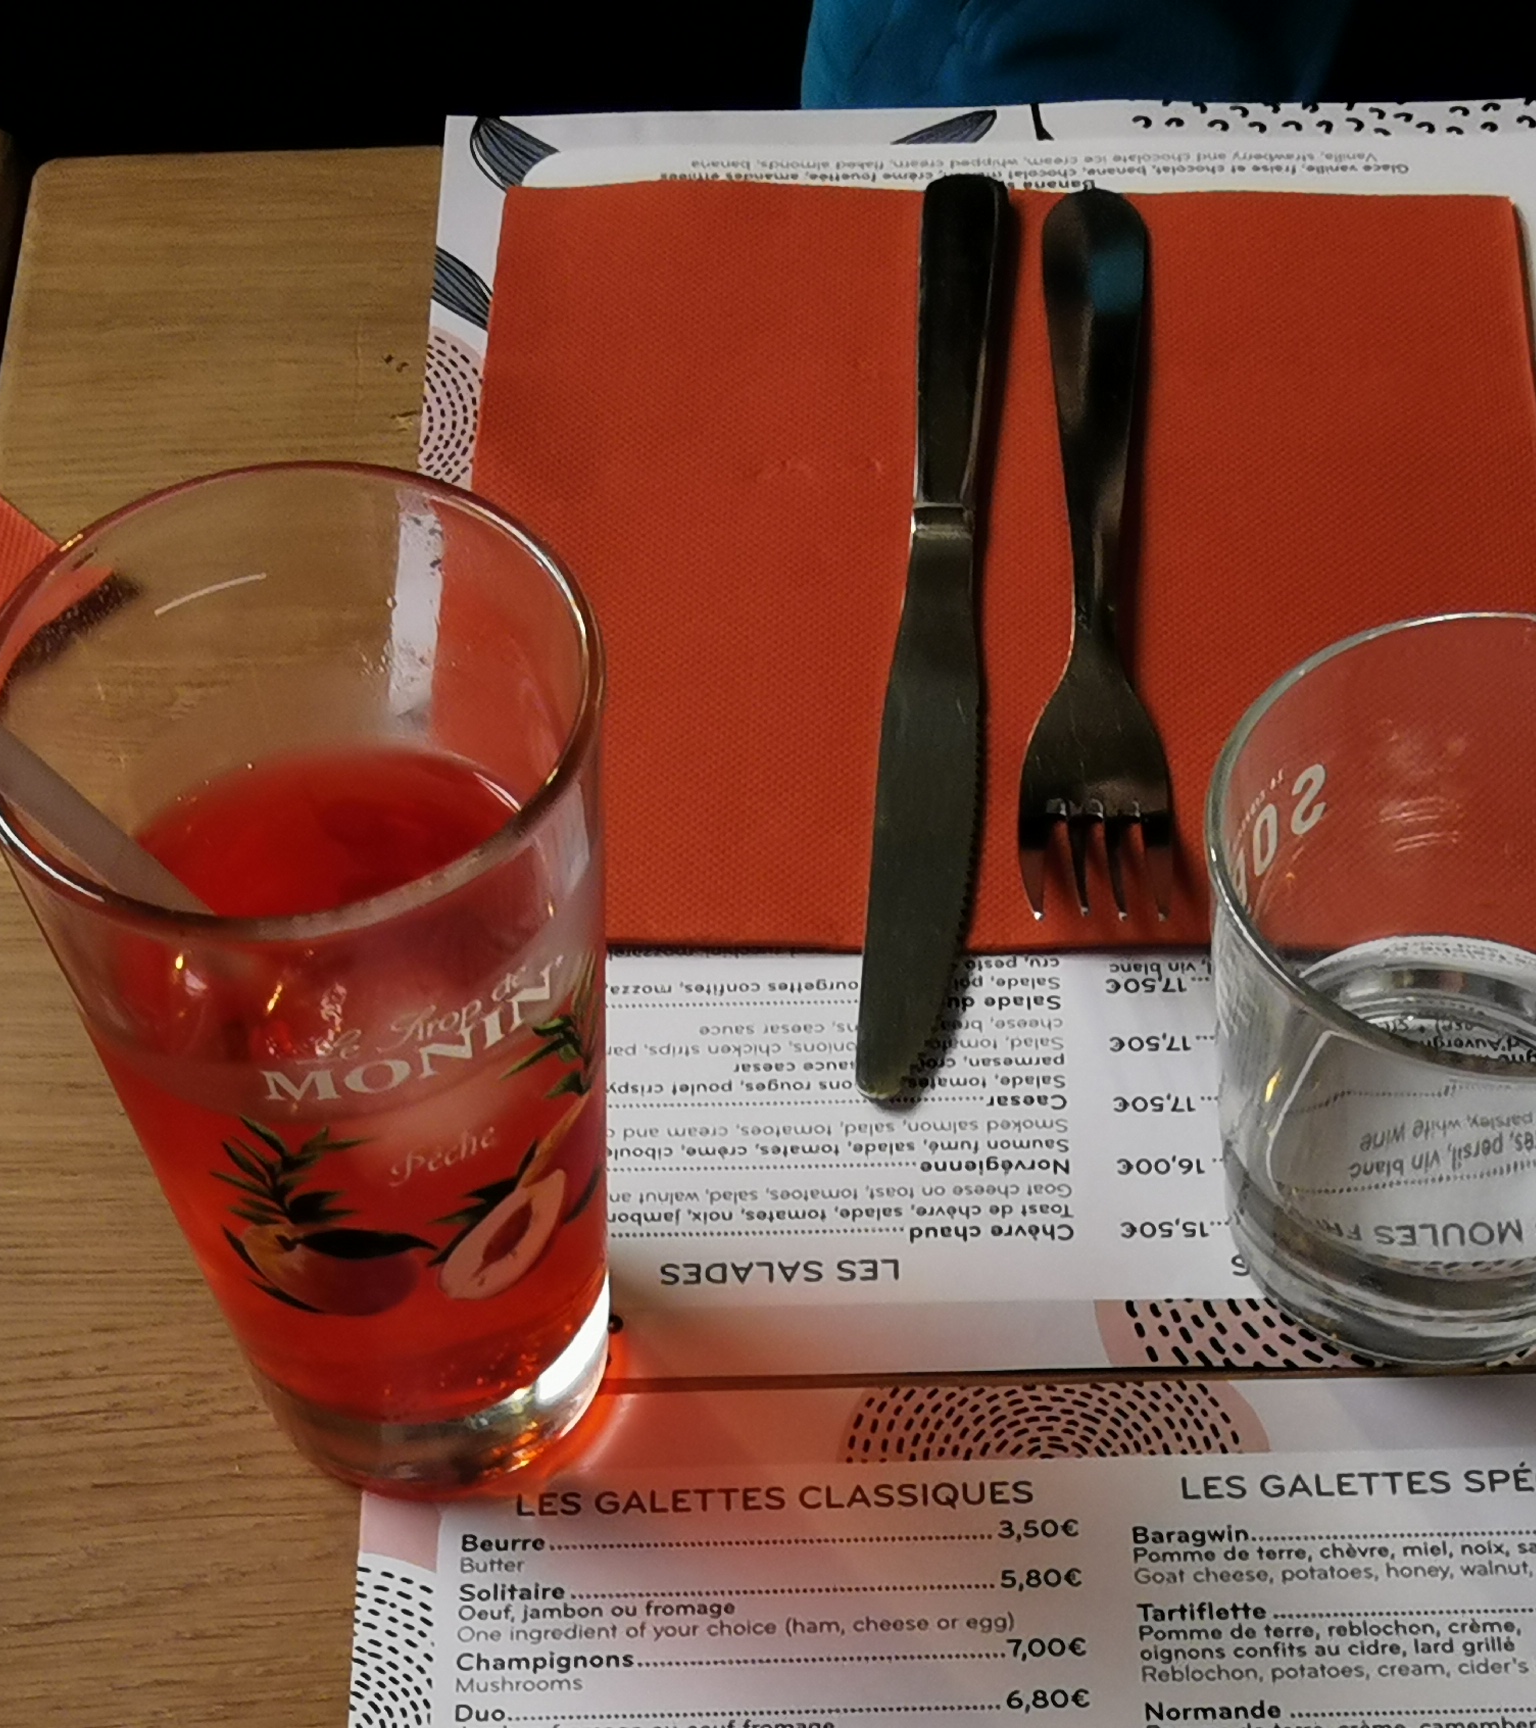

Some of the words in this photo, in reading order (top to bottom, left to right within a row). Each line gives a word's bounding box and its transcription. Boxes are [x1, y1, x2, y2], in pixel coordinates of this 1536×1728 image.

[260, 955, 563, 1100] MONIN
[661, 1261, 823, 1285] SALADES
[837, 1259, 899, 1282] LES
[515, 1486, 582, 1516] LES
[595, 1487, 785, 1514] GALETTES
[799, 1481, 1033, 1510] CLASSIQUES
[1181, 1476, 1247, 1499] LES
[1260, 1471, 1451, 1498] GALETTES
[462, 1534, 545, 1552] Beurre
[998, 1519, 1078, 1542] 3,50€
[1132, 1525, 1249, 1547] Baragwin
[1133, 1543, 1215, 1563] Pomme
[1224, 1546, 1249, 1561] de
[1257, 1546, 1312, 1562] terre,
[1320, 1543, 1395, 1560] chèvre,
[1403, 1541, 1453, 1558] miel,
[1461, 1540, 1510, 1557] noix,
[459, 1583, 564, 1602] Solitaire
[1001, 1568, 1082, 1592] 5,80€
[458, 1604, 512, 1621] Oeuf,
[522, 1603, 603, 1623] jambon
[611, 1606, 637, 1617] ou
[645, 1600, 735, 1619] fromage
[457, 1651, 634, 1674] Champignons
[1006, 1637, 1086, 1661] 7,00€
[455, 1704, 505, 1722] Duo
[1007, 1689, 1089, 1713] 6,80€
[1145, 1700, 1281, 1721] Normande
